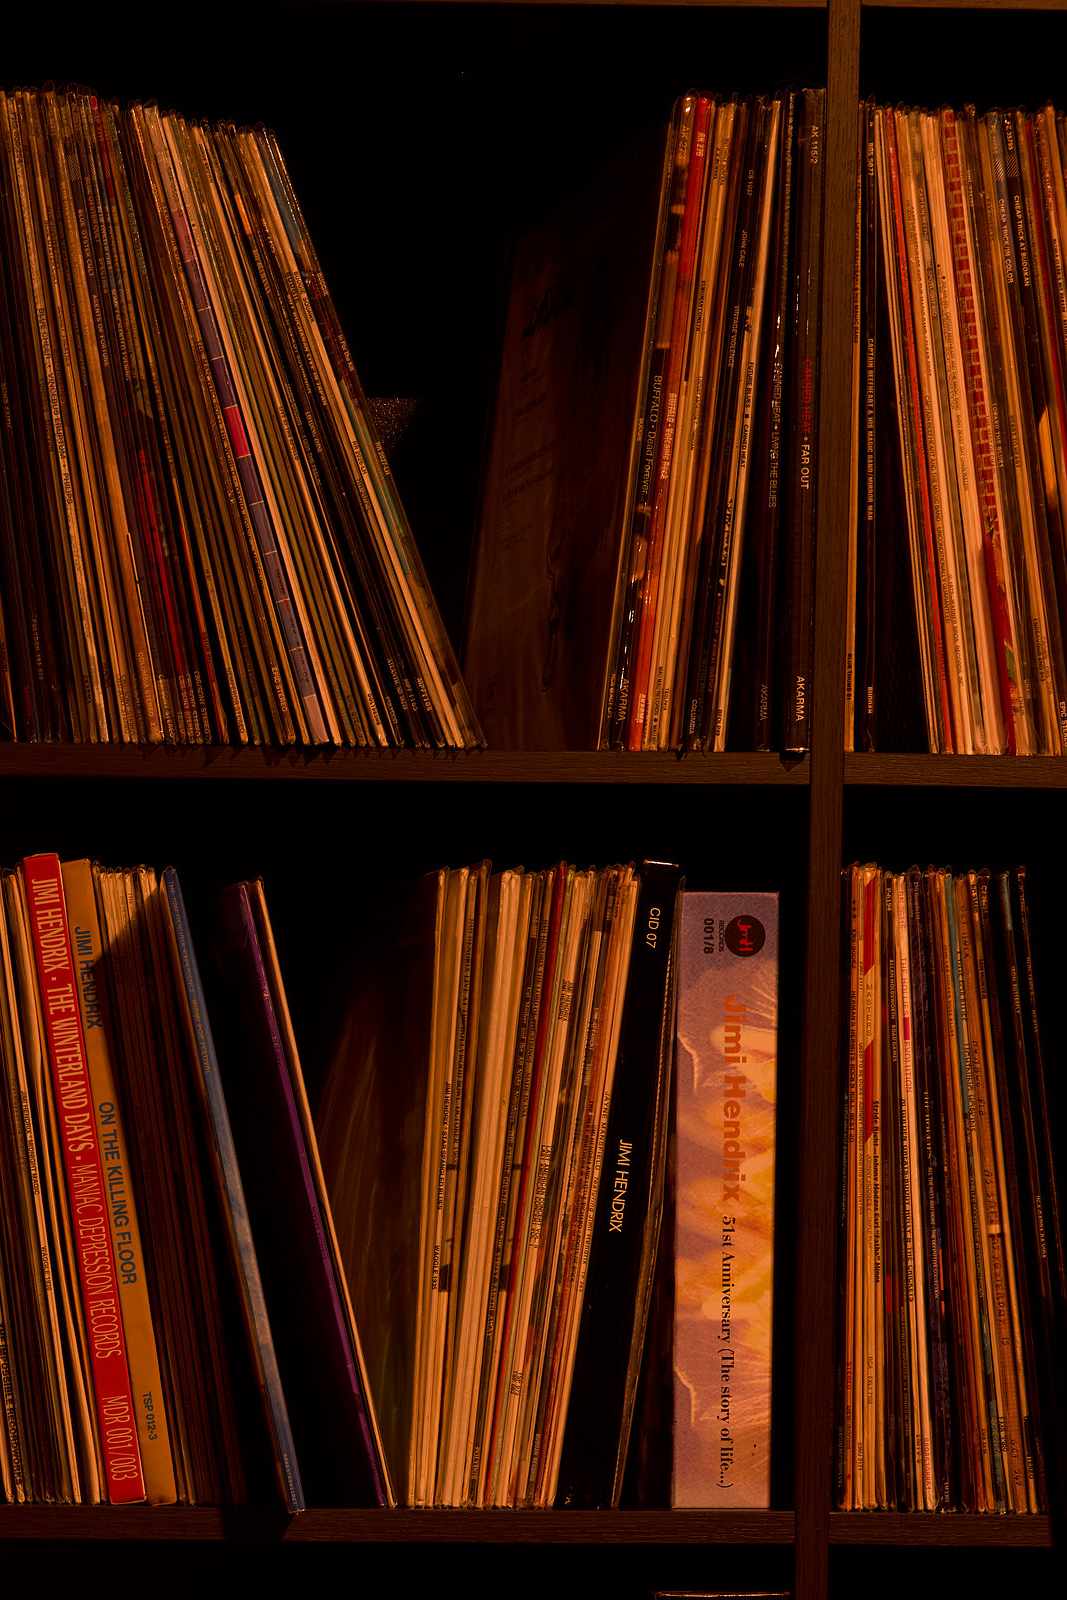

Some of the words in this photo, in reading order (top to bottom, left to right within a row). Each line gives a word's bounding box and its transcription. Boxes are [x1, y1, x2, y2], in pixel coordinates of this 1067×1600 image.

[679, 125, 690, 139] AK
[696, 132, 707, 142] AK
[810, 125, 819, 140] AK
[677, 141, 689, 160] 273
[695, 144, 705, 157] 276
[809, 142, 818, 164] 115/2
[748, 169, 755, 180] CS
[1013, 195, 1022, 218] CHEAP
[740, 229, 748, 246] JOHN
[998, 198, 1007, 220] CHEAP
[1005, 259, 1014, 283] COLOR
[1016, 219, 1024, 240] TRICK
[738, 248, 746, 268] CALE
[1018, 241, 1025, 251] AT
[1019, 252, 1030, 287] BUDOKAN
[730, 305, 740, 333] VINTAGE
[727, 334, 737, 368] VIOLENCE
[746, 362, 755, 385] FUTURE
[773, 363, 784, 398] CANNED
[802, 359, 812, 401] CANNED
[37, 308, 47, 327] BLUE
[46, 373, 60, 416] VINCEBUS
[53, 418, 67, 459] ERUPTUM
[62, 473, 73, 504] PHILIPS
[648, 375, 663, 423] BUFFALO
[744, 386, 753, 408] BLUES
[772, 401, 782, 424] HEAT
[802, 403, 812, 434] HEAT
[645, 431, 657, 457] Dead
[741, 424, 750, 449] CANNED
[770, 432, 780, 460] LIVING
[739, 450, 748, 468] HEAT
[801, 444, 810, 464] FAR
[659, 461, 671, 480] Rock
[770, 461, 779, 478] THE
[800, 466, 809, 490] OUT
[768, 480, 779, 508] BLUES
[617, 678, 630, 722] AKARMA
[636, 693, 647, 724] AKARMA
[759, 684, 769, 721] AKARMA
[795, 675, 805, 722] AKARMA
[688, 699, 698, 734] COLUMBIA
[31, 878, 61, 904] JIMI
[647, 907, 661, 930] CID
[36, 909, 69, 974] HENDRIX
[74, 926, 93, 956] JIMI
[646, 933, 657, 948] 07
[703, 918, 714, 954] 001/8
[46, 984, 76, 1015] THE
[79, 960, 102, 1029] HENDRIX
[723, 994, 747, 1064] Jimi
[51, 1016, 89, 1109] WINTERLAND
[98, 1102, 116, 1126] ON
[442, 1098, 450, 1126] HENDRIX
[63, 1113, 95, 1153] DAYS
[101, 1130, 122, 1160] THE
[440, 1131, 448, 1149] STAR
[723, 1076, 746, 1203] Hendrix
[617, 1139, 633, 1166] JIMI
[437, 1150, 446, 1186] SPANGLED
[70, 1163, 104, 1214] MANIAC
[107, 1166, 129, 1228] KILLING
[609, 1170, 629, 1232] HENDRIX
[722, 1215, 736, 1247] 51st
[77, 1218, 113, 1295] DEPRESSION
[115, 1231, 137, 1285] FLOOR
[432, 1245, 440, 1273] WAGGLE
[718, 1252, 735, 1343] Anniversary
[87, 1299, 122, 1359] RECORDS
[718, 1348, 735, 1382] (The
[101, 1395, 130, 1425] MDR
[142, 1391, 154, 1412] TSP
[717, 1386, 733, 1424] story
[145, 1413, 157, 1441] 012-3
[720, 1428, 734, 1445] of
[107, 1428, 138, 1481] 001/003
